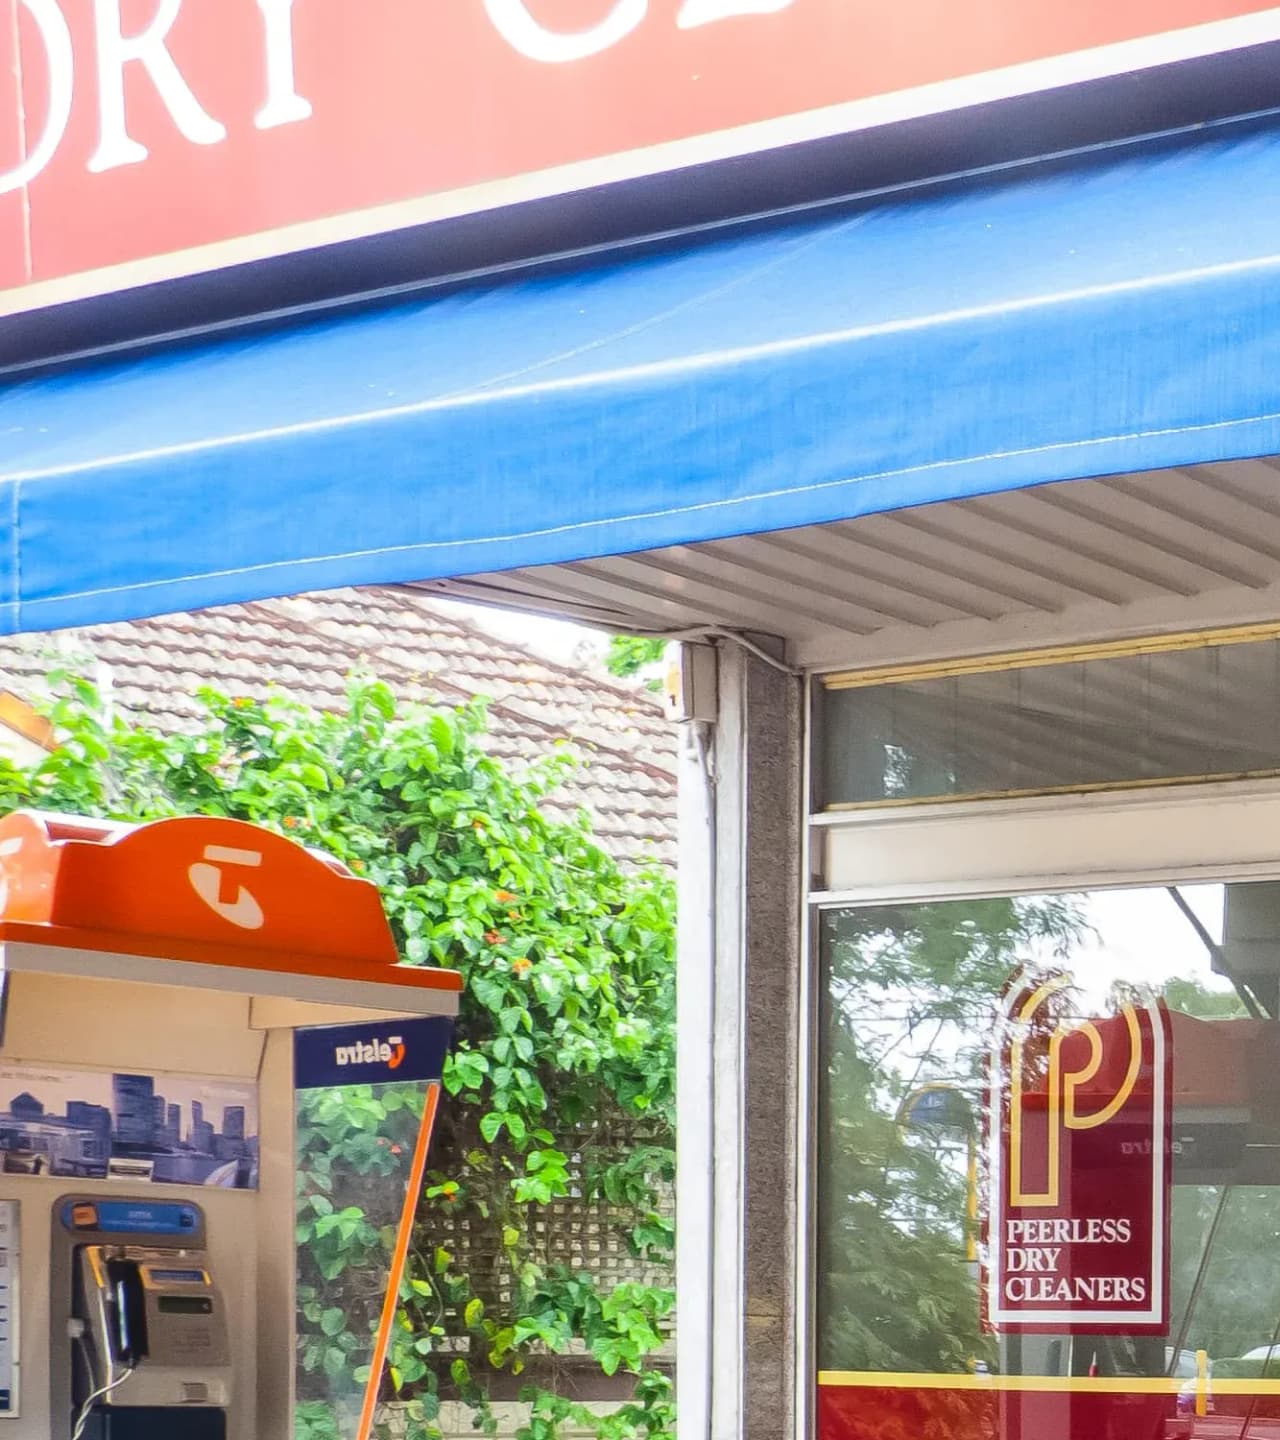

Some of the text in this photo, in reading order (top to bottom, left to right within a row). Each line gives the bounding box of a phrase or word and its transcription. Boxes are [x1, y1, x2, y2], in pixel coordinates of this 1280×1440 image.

[1006, 1219, 1131, 1244] PEERLESS
[1006, 1248, 1062, 1273] DRY
[1005, 1277, 1146, 1302] CLEANERS
